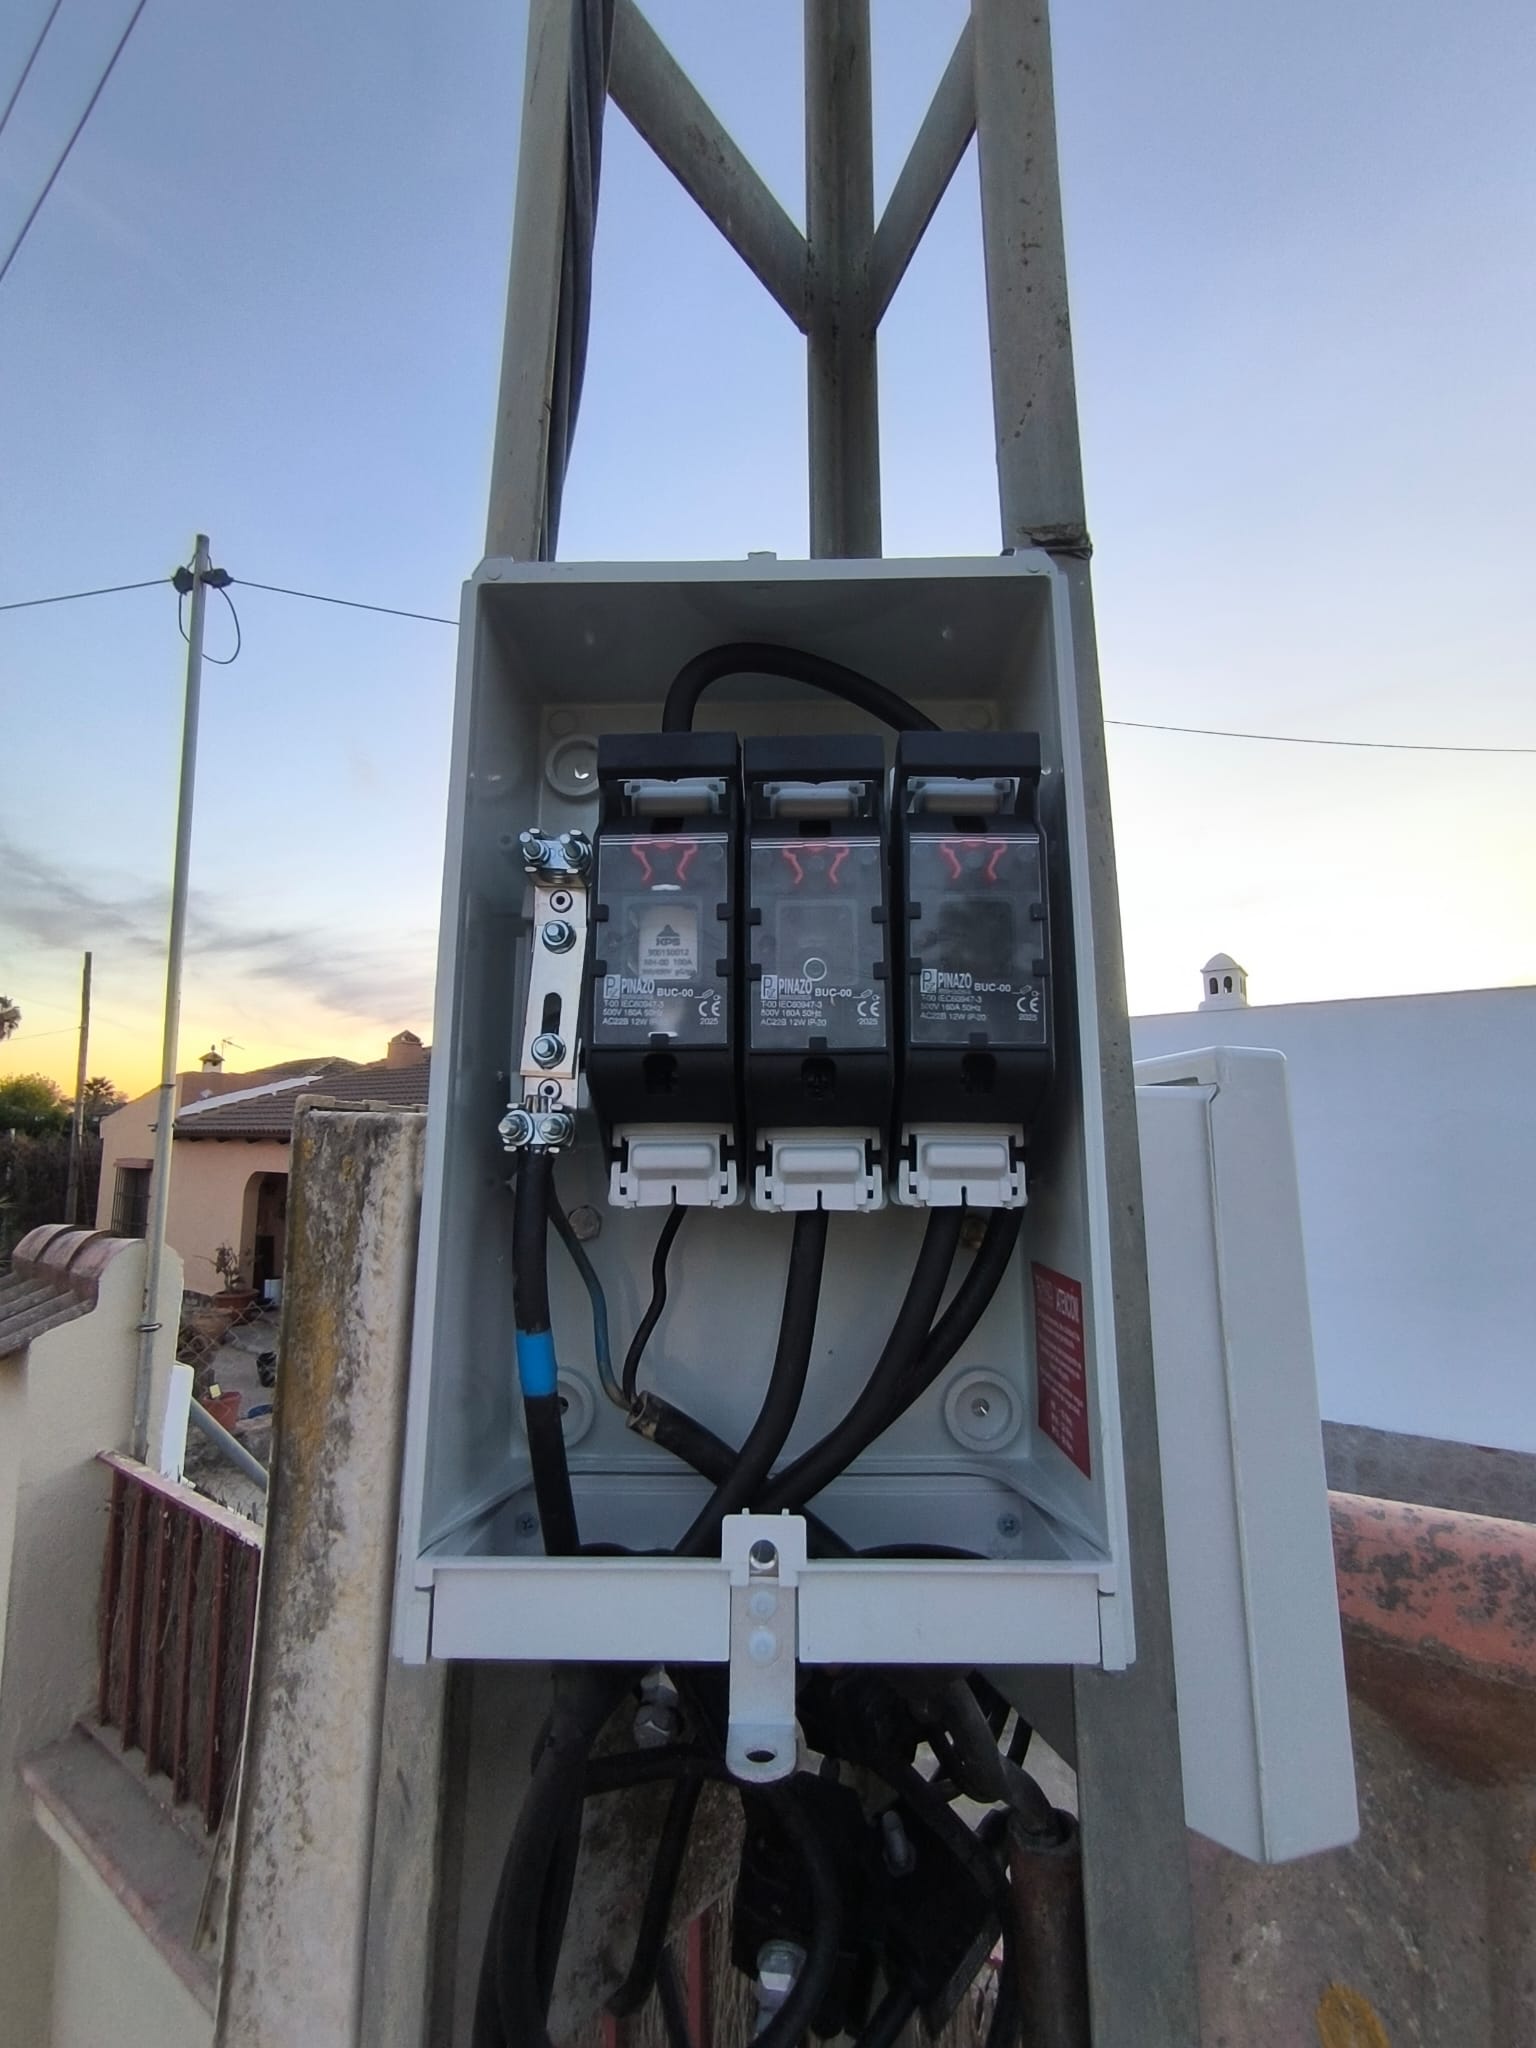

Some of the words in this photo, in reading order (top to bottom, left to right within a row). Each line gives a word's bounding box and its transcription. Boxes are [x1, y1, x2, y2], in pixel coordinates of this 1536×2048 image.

[621, 979, 655, 994] PINAZO
[656, 987, 694, 998] BUC-00
[779, 978, 813, 995] PINAZO
[814, 987, 852, 998] BUC-00
[938, 972, 973, 990] PINAZO
[974, 982, 1012, 993] BUC-00
